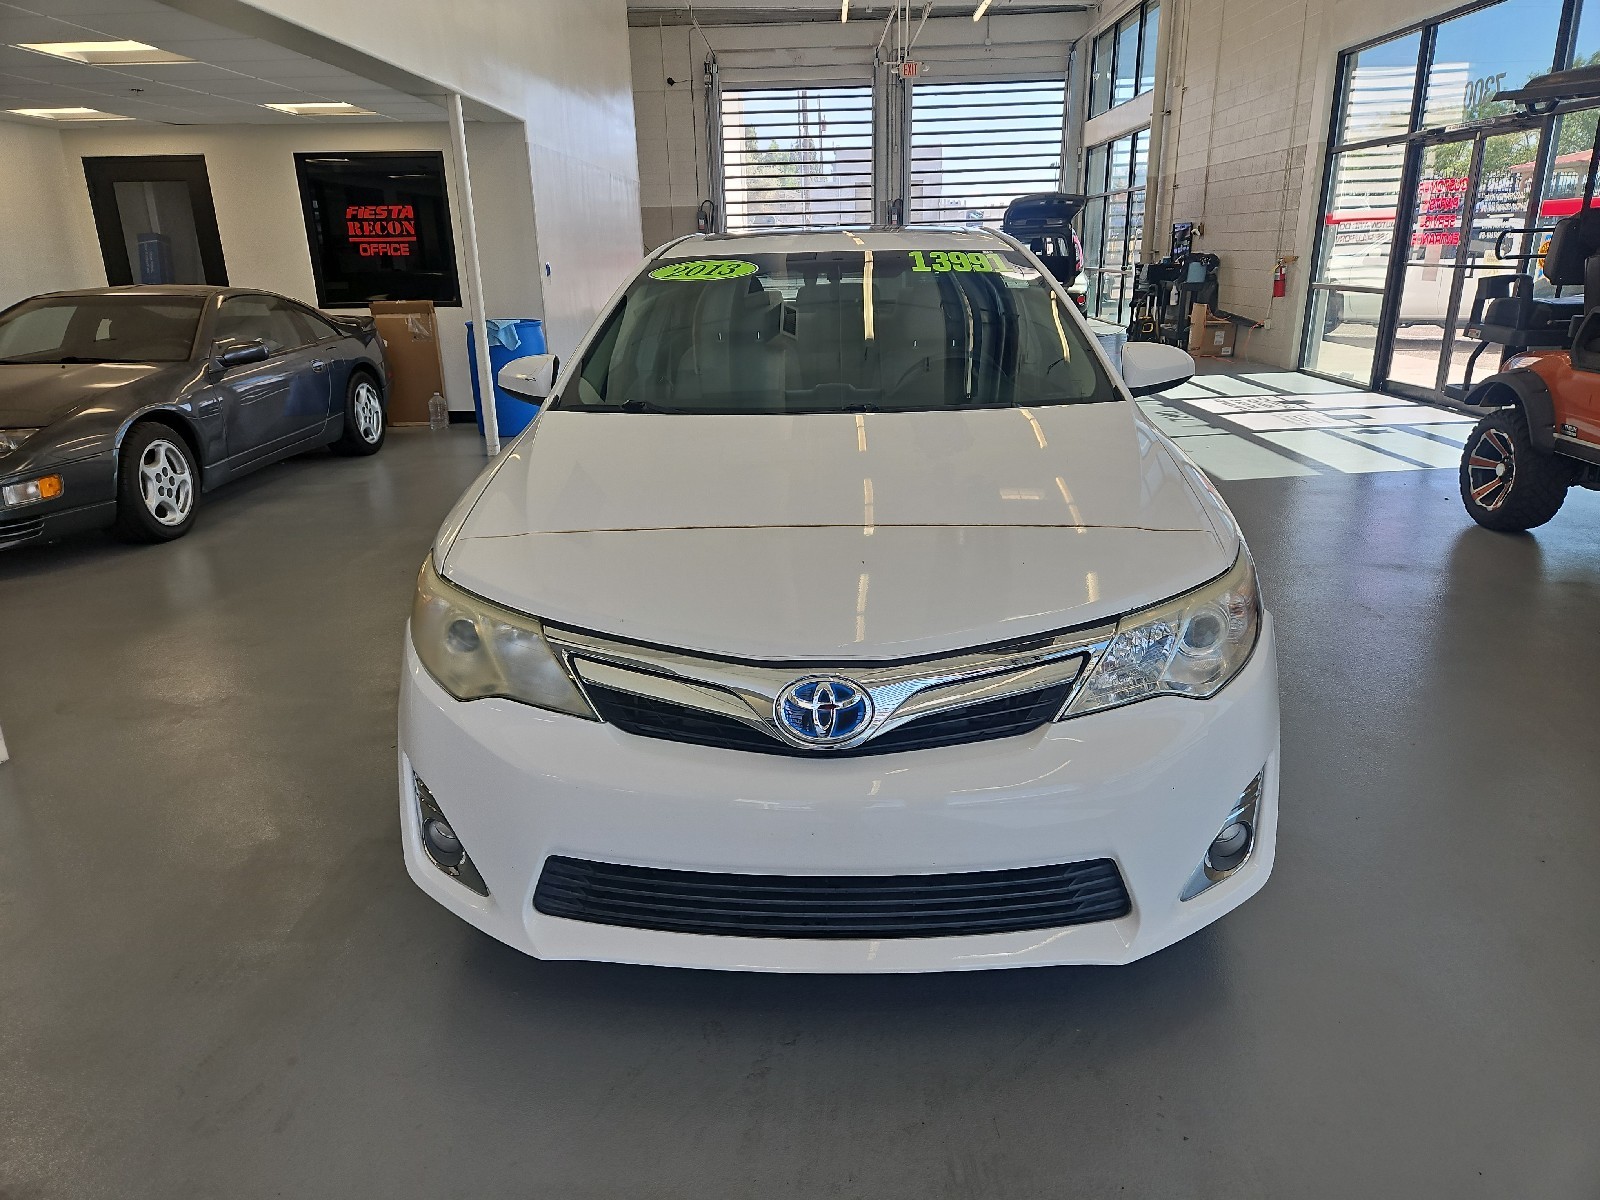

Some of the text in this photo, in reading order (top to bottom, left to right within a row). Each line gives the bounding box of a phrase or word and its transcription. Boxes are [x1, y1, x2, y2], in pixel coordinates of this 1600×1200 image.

[903, 63, 918, 76] EXIT
[345, 205, 414, 219] FIESTA
[347, 221, 415, 235] RECON
[360, 243, 410, 256] OFFICE
[664, 263, 742, 278] 2013
